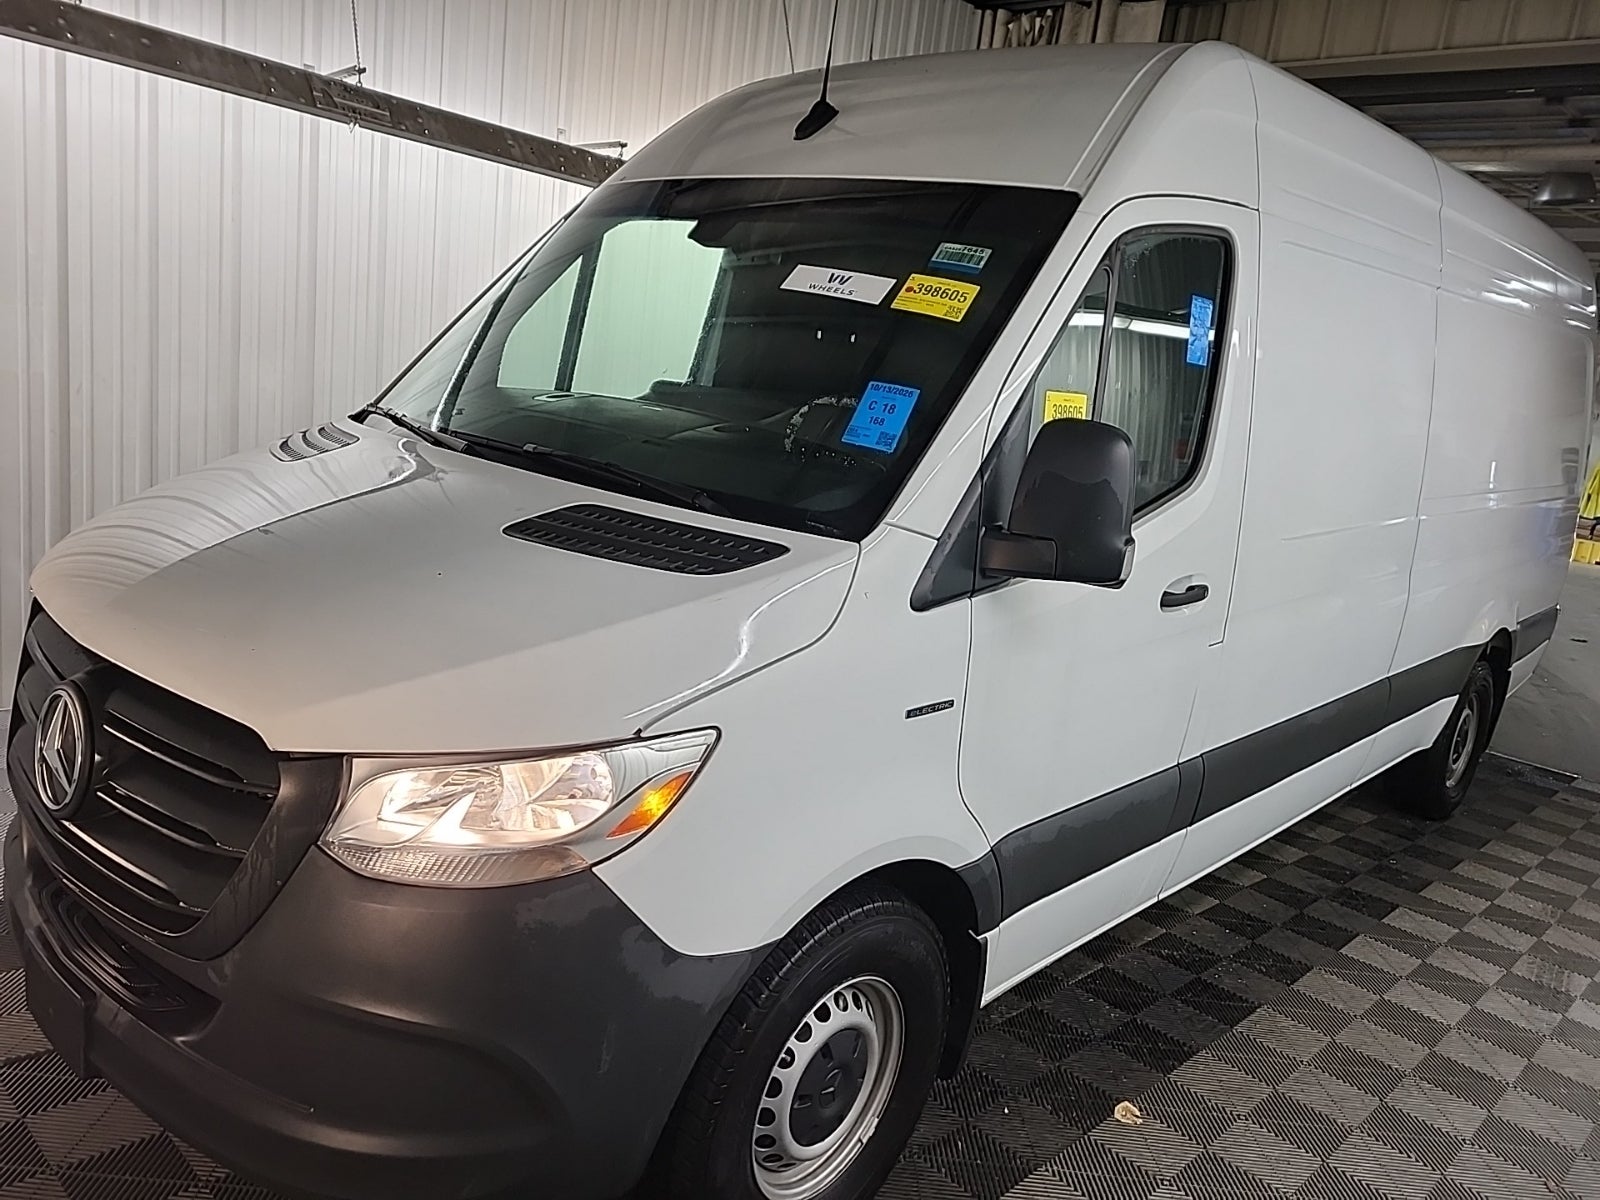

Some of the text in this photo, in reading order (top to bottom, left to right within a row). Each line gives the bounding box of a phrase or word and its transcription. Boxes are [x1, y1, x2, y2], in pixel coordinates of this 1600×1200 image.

[808, 283, 855, 296] WHEELS
[913, 283, 970, 304] 398605
[868, 400, 897, 415] C 18
[1052, 403, 1083, 419] 398605
[869, 416, 886, 426] 168
